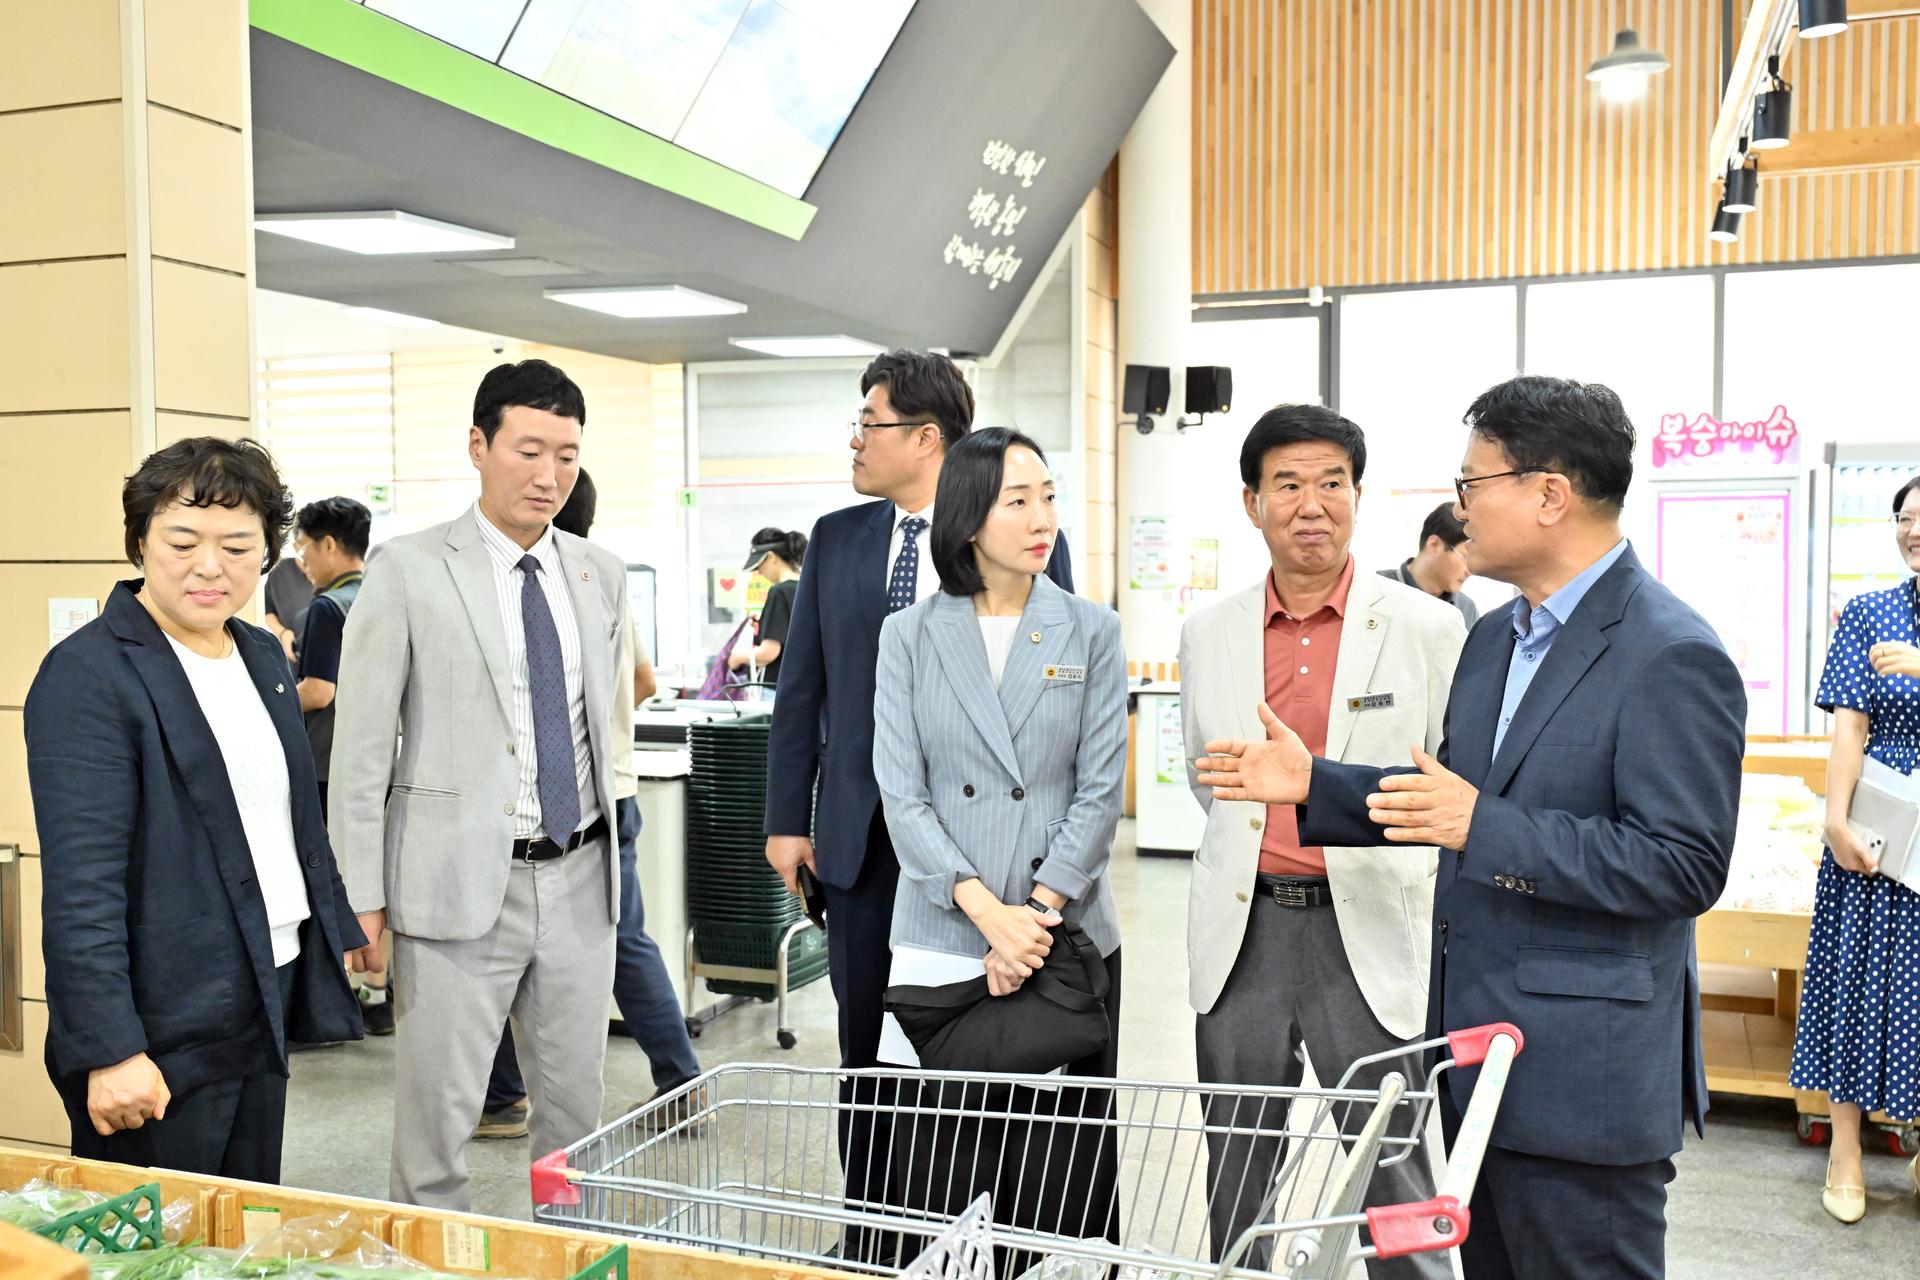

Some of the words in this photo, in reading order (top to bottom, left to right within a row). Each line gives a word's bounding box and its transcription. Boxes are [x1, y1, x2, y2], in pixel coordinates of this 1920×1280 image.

[968, 188, 1000, 228] 행복한
[992, 195, 1027, 236] 농민
[1659, 405, 1796, 457] 복숭아이슈
